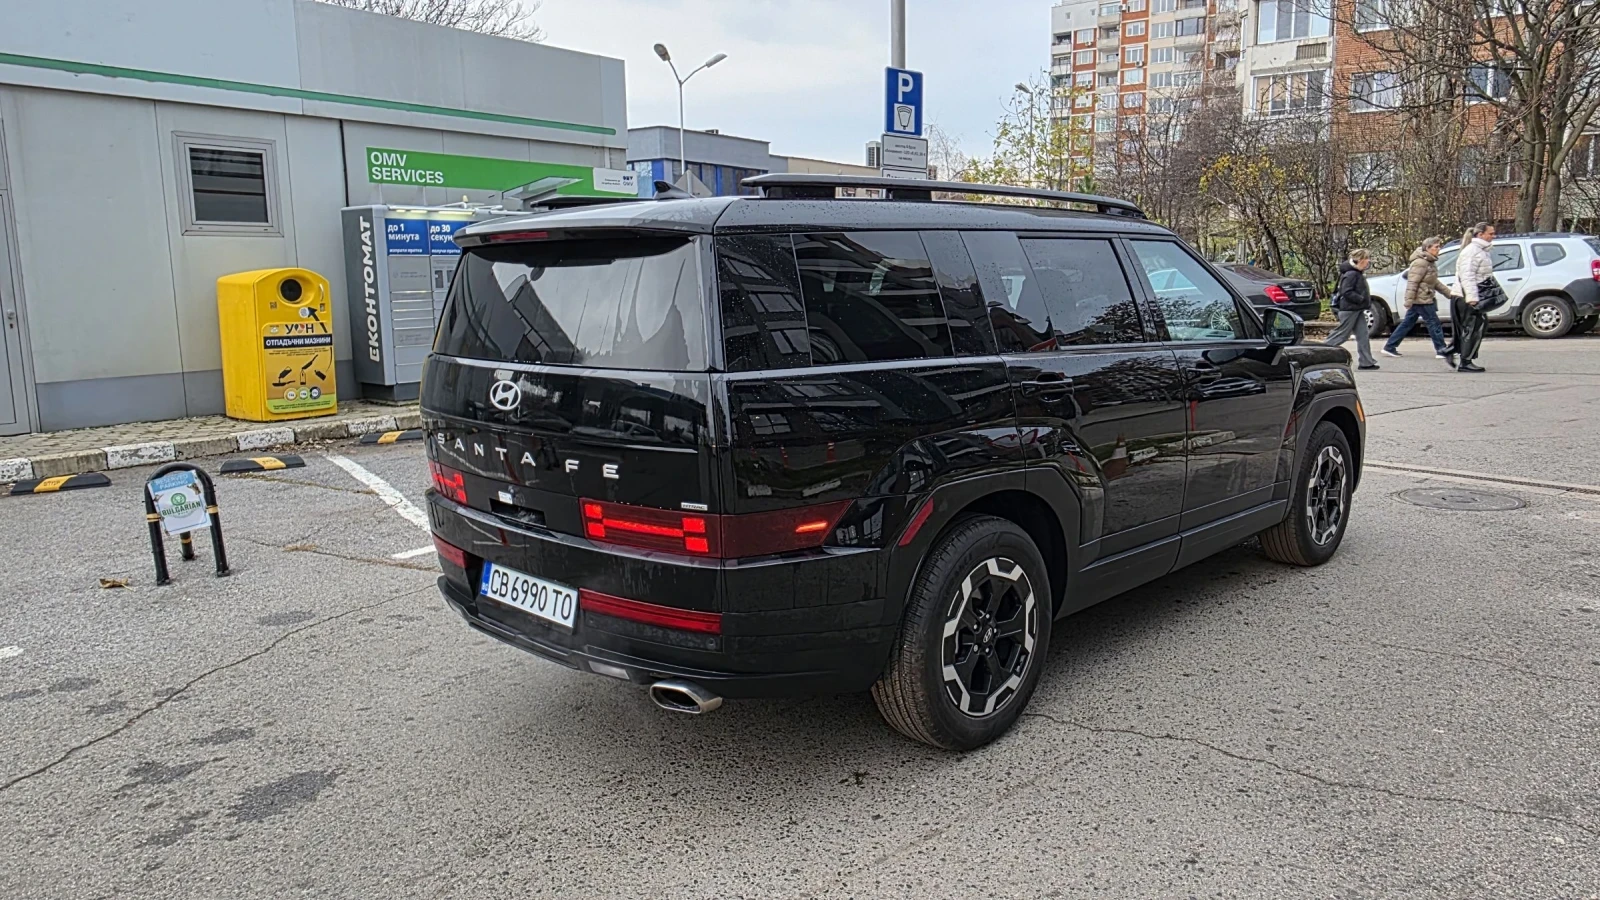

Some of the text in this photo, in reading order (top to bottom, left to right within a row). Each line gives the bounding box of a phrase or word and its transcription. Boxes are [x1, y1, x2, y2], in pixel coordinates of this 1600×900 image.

[898, 72, 913, 102] P
[370, 151, 407, 167] OMV
[371, 166, 444, 184] SERVICES
[387, 223, 405, 233] до 1
[430, 224, 451, 233] до 30
[388, 233, 420, 243] минута
[430, 234, 453, 243] секун
[359, 215, 380, 362] ЕКОНТОМАТ
[265, 336, 331, 347] ОТПАДЪЧНИ МАЗНИНИ
[437, 432, 620, 480] SANTA FE
[161, 500, 202, 516] BULGARIAN
[490, 569, 572, 620] CB 6990 TO
